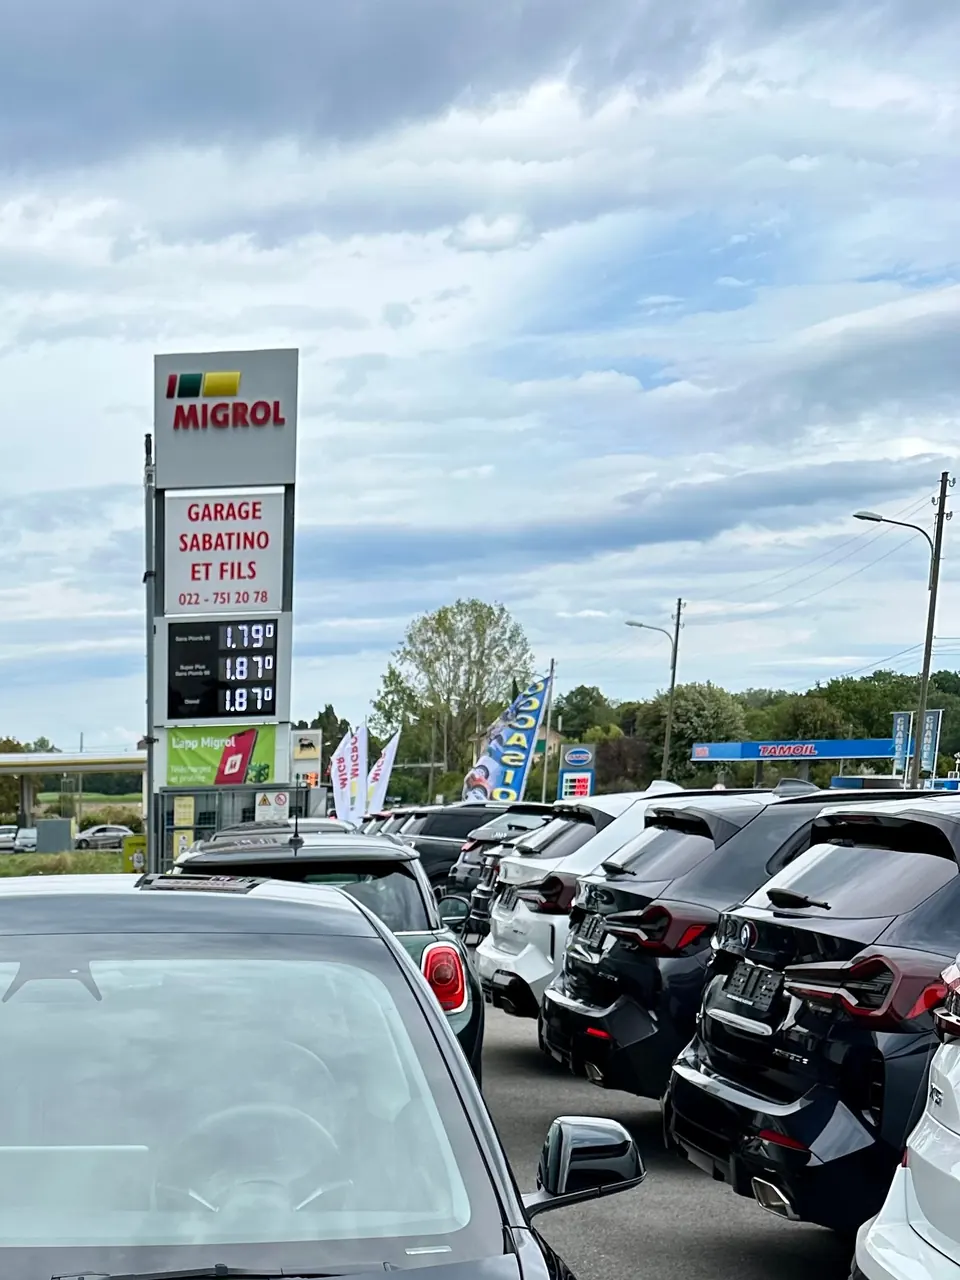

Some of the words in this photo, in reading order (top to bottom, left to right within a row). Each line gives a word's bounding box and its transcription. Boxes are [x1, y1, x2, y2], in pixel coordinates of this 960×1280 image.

[173, 401, 285, 430] MIGROL
[187, 501, 262, 522] GARAGE
[179, 531, 269, 552] SABATINO
[191, 562, 213, 581] ET
[219, 561, 257, 580] FILS
[178, 592, 200, 606] 022
[212, 591, 231, 604] 751
[235, 591, 250, 604] 20
[253, 590, 268, 603] 78
[200, 736, 236, 750] Migrol
[758, 744, 818, 757] TAMOIL
